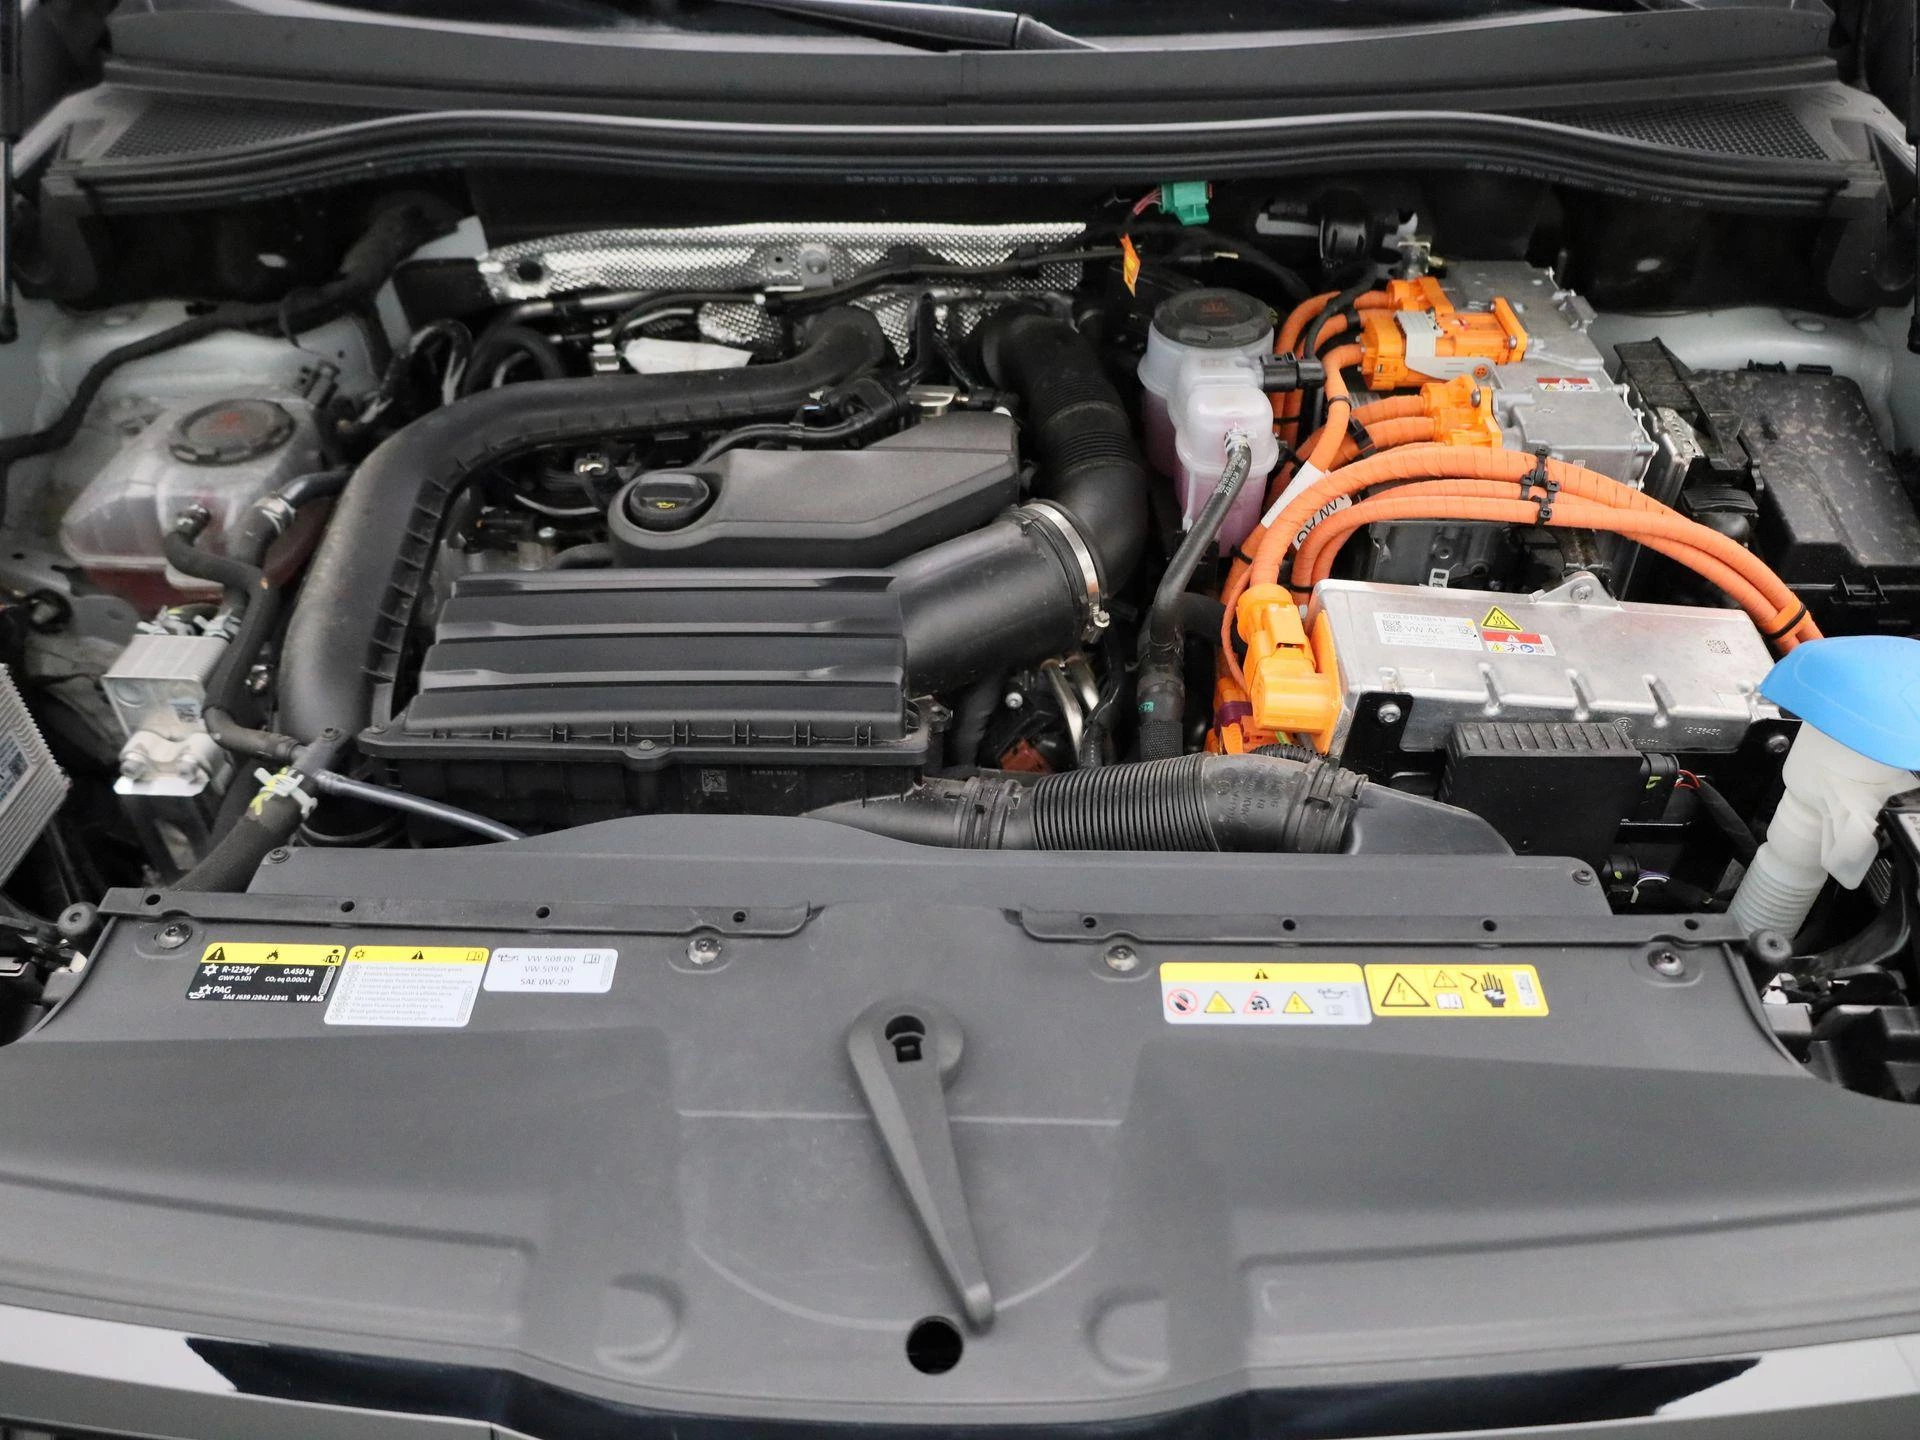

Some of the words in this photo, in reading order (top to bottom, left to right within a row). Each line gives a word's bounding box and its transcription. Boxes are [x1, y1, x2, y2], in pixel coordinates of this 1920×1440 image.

[527, 955, 543, 963] VW
[545, 955, 561, 963] 508
[564, 955, 576, 963] 00
[221, 965, 260, 975] R-1234yf
[283, 967, 304, 975] 0.450
[305, 968, 315, 976] kg
[524, 965, 540, 973] VW
[561, 965, 574, 973] 00
[212, 985, 232, 994] PAG
[296, 994, 310, 1002] VW
[311, 994, 324, 1002] AG
